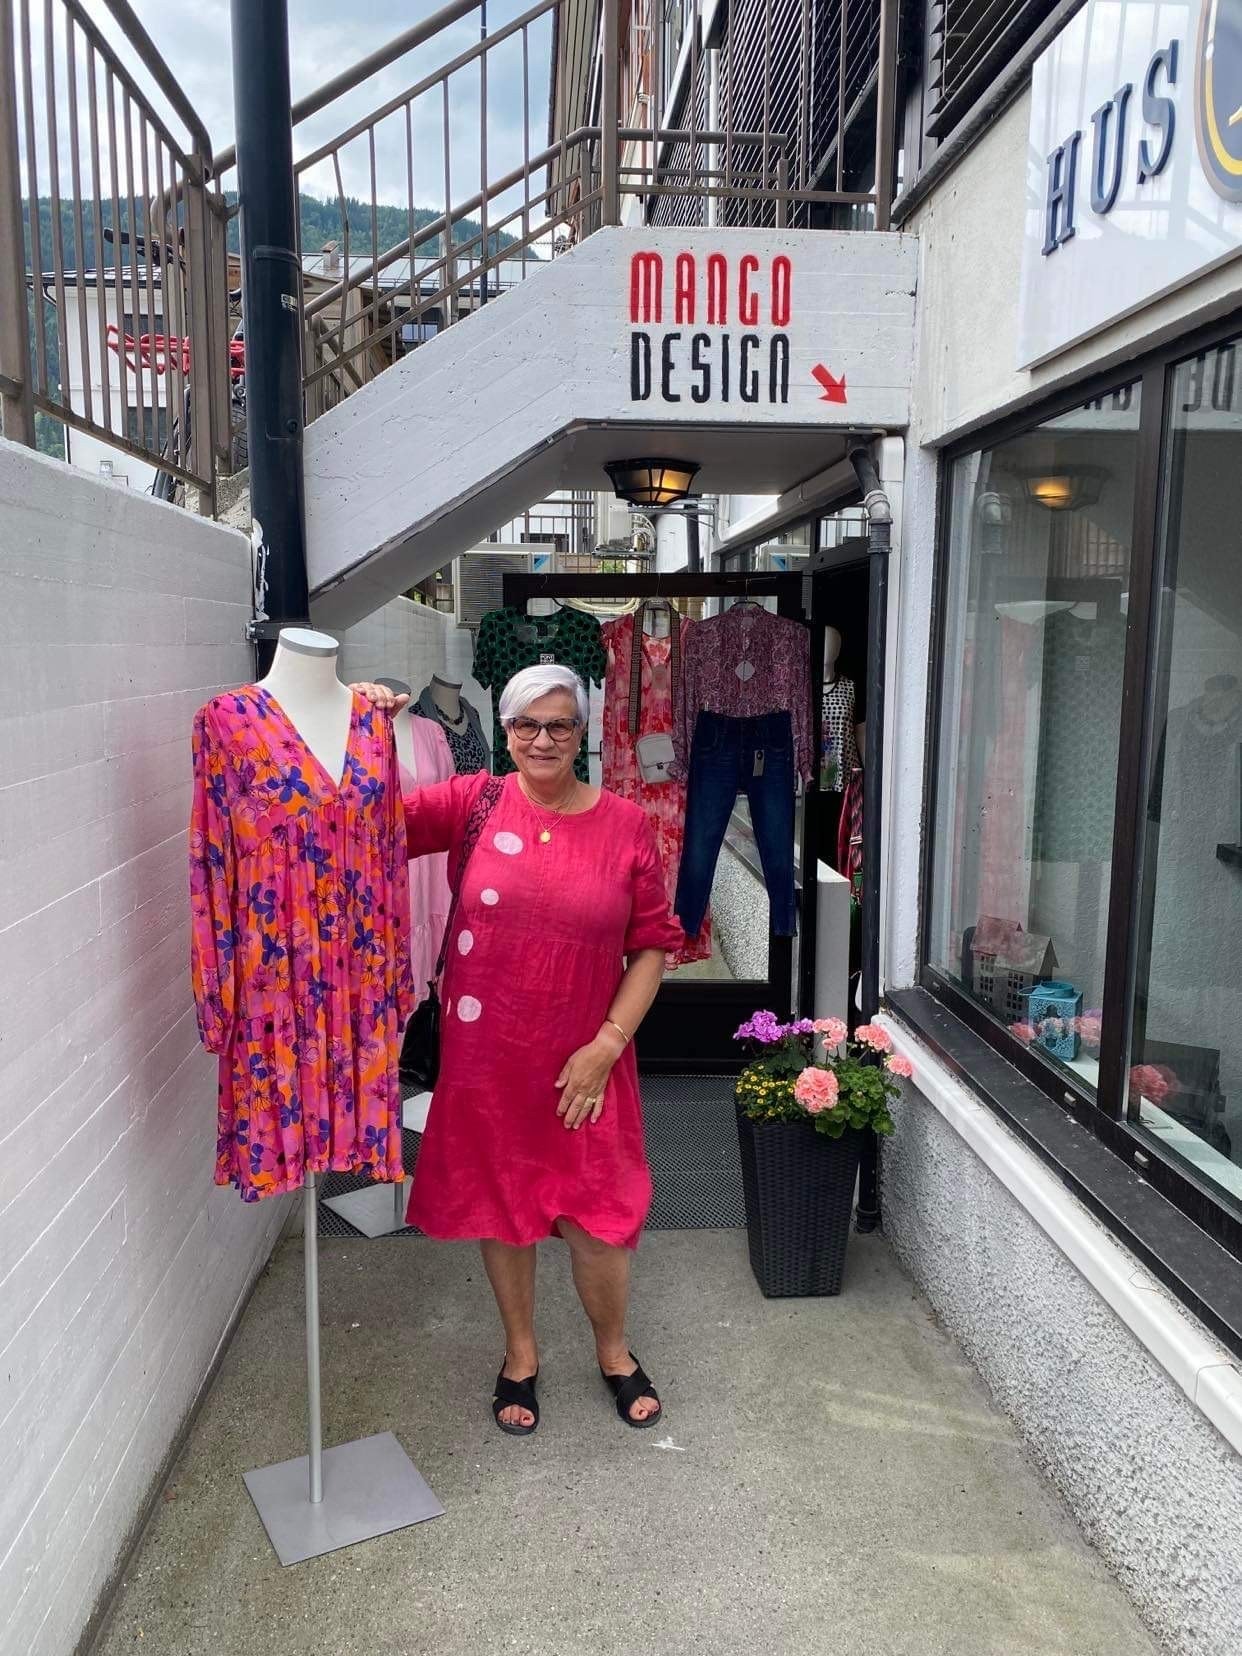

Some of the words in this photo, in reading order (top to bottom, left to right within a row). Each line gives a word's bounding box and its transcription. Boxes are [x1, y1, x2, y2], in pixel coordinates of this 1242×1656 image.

[1042, 39, 1179, 256] HUS
[630, 252, 791, 327] MANGO
[630, 331, 790, 403] DESIGN
